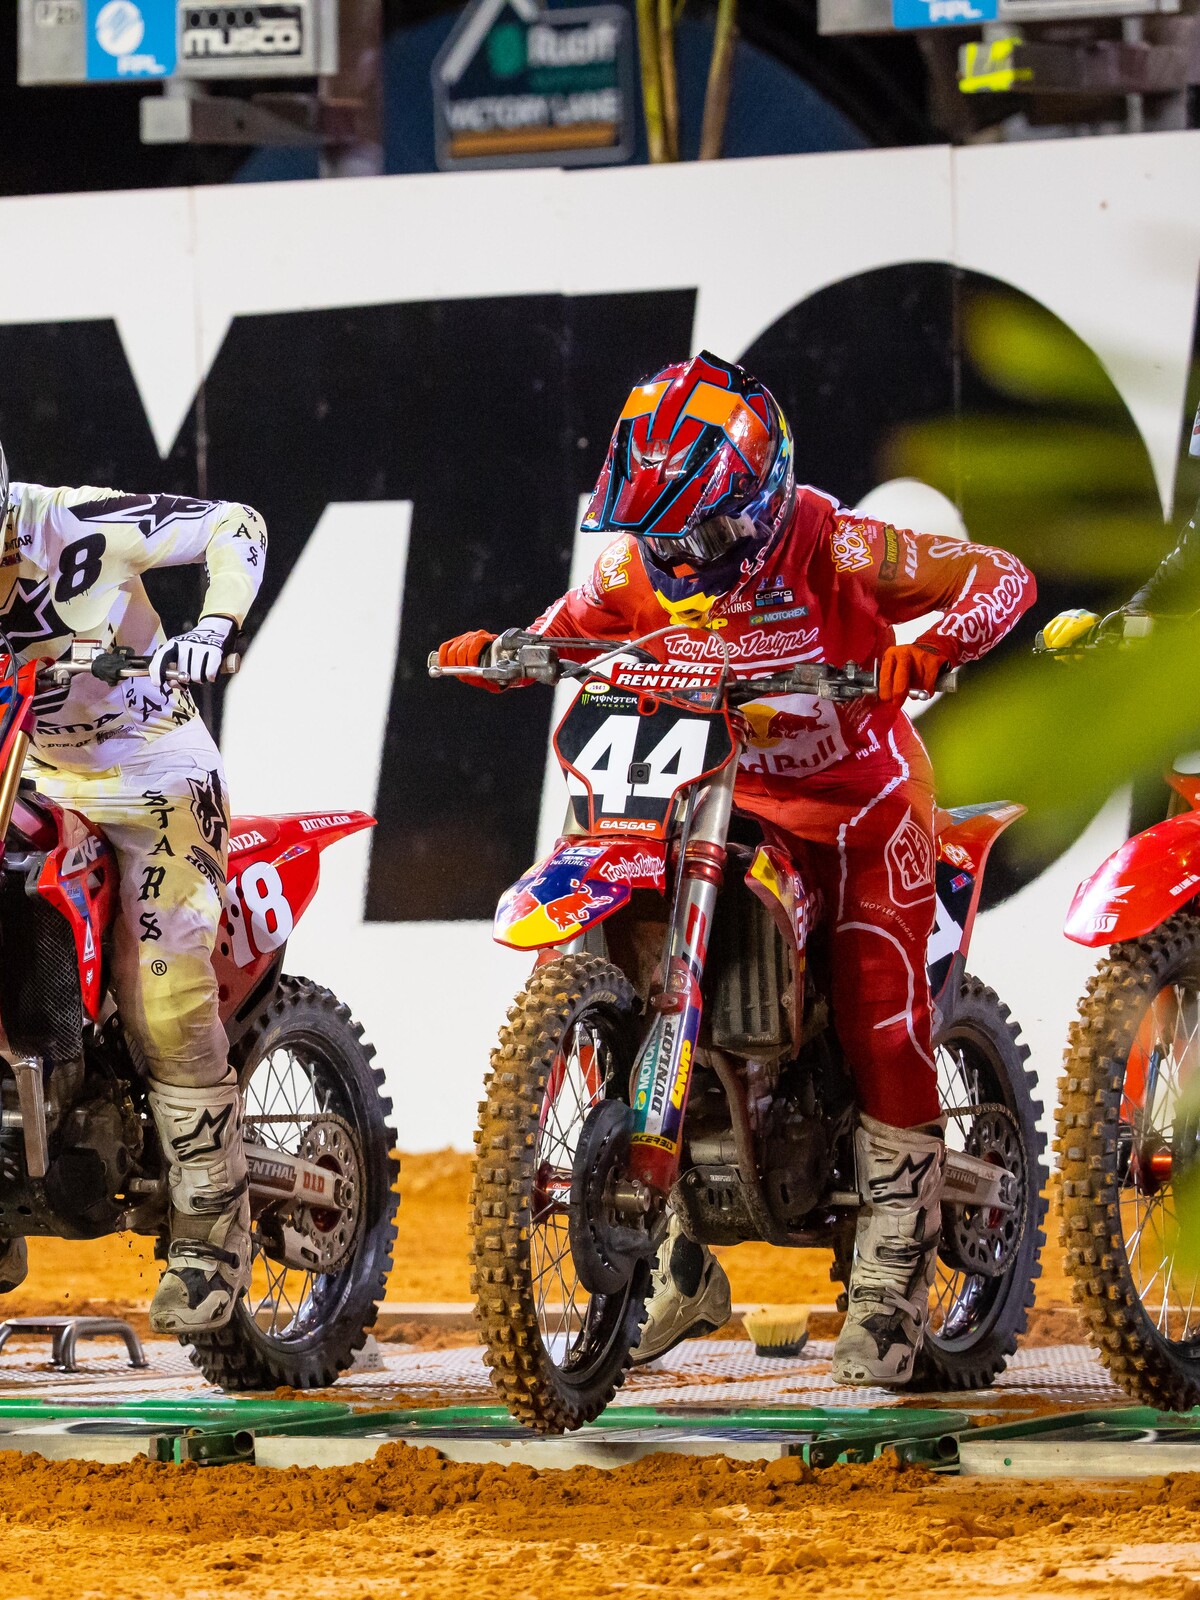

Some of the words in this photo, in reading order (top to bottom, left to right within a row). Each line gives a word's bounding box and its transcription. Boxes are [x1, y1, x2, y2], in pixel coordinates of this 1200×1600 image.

[755, 590, 793, 600] GoPro
[764, 606, 807, 622] MOTOREX
[664, 633, 705, 662] Troy
[704, 635, 742, 659] Lee
[740, 627, 820, 658] Designs
[615, 673, 712, 688] RENTHAL
[590, 694, 638, 704] MONSTER
[567, 714, 711, 814] 44
[774, 734, 837, 777] Bull
[298, 815, 352, 833] DUNLOP
[599, 820, 657, 831] GASGAS
[599, 859, 631, 885] Troy
[225, 860, 294, 969] 18
[651, 1021, 675, 1116] DUNLOP
[248, 1156, 297, 1183] ENTHAL
[945, 1169, 978, 1186] ENTHAL
